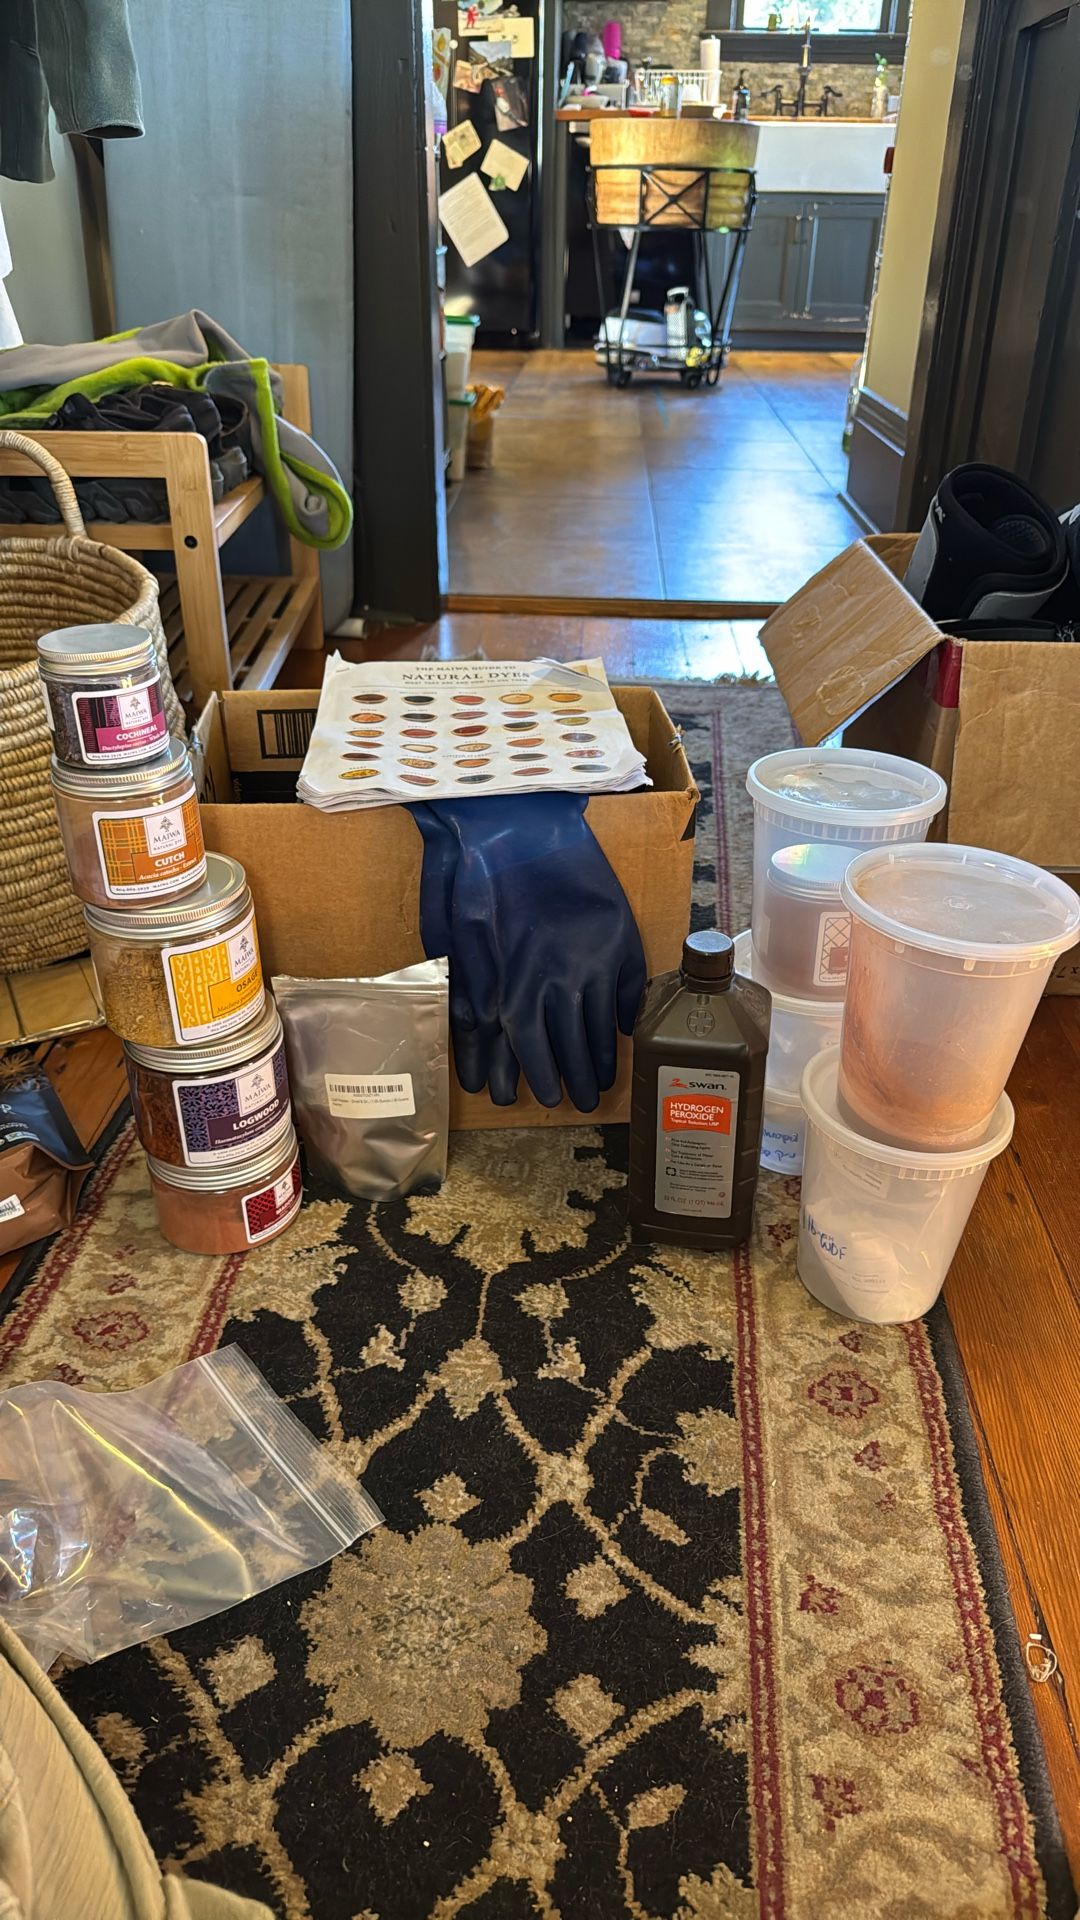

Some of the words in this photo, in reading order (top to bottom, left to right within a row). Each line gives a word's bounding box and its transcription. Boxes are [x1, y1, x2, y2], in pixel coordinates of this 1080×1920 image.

[125, 708, 148, 718] MAIWA
[116, 724, 158, 741] COCHINEAL
[153, 830, 180, 843] MAIWA
[155, 851, 185, 867] CUTCH
[234, 948, 254, 967] MAIWA
[236, 970, 258, 992] OSAGE
[244, 1084, 271, 1102] MAIWA
[232, 1099, 280, 1131] LOGWOOD
[670, 1102, 724, 1114] HYDROGEN
[670, 1110, 714, 1120] PEROXIDE
